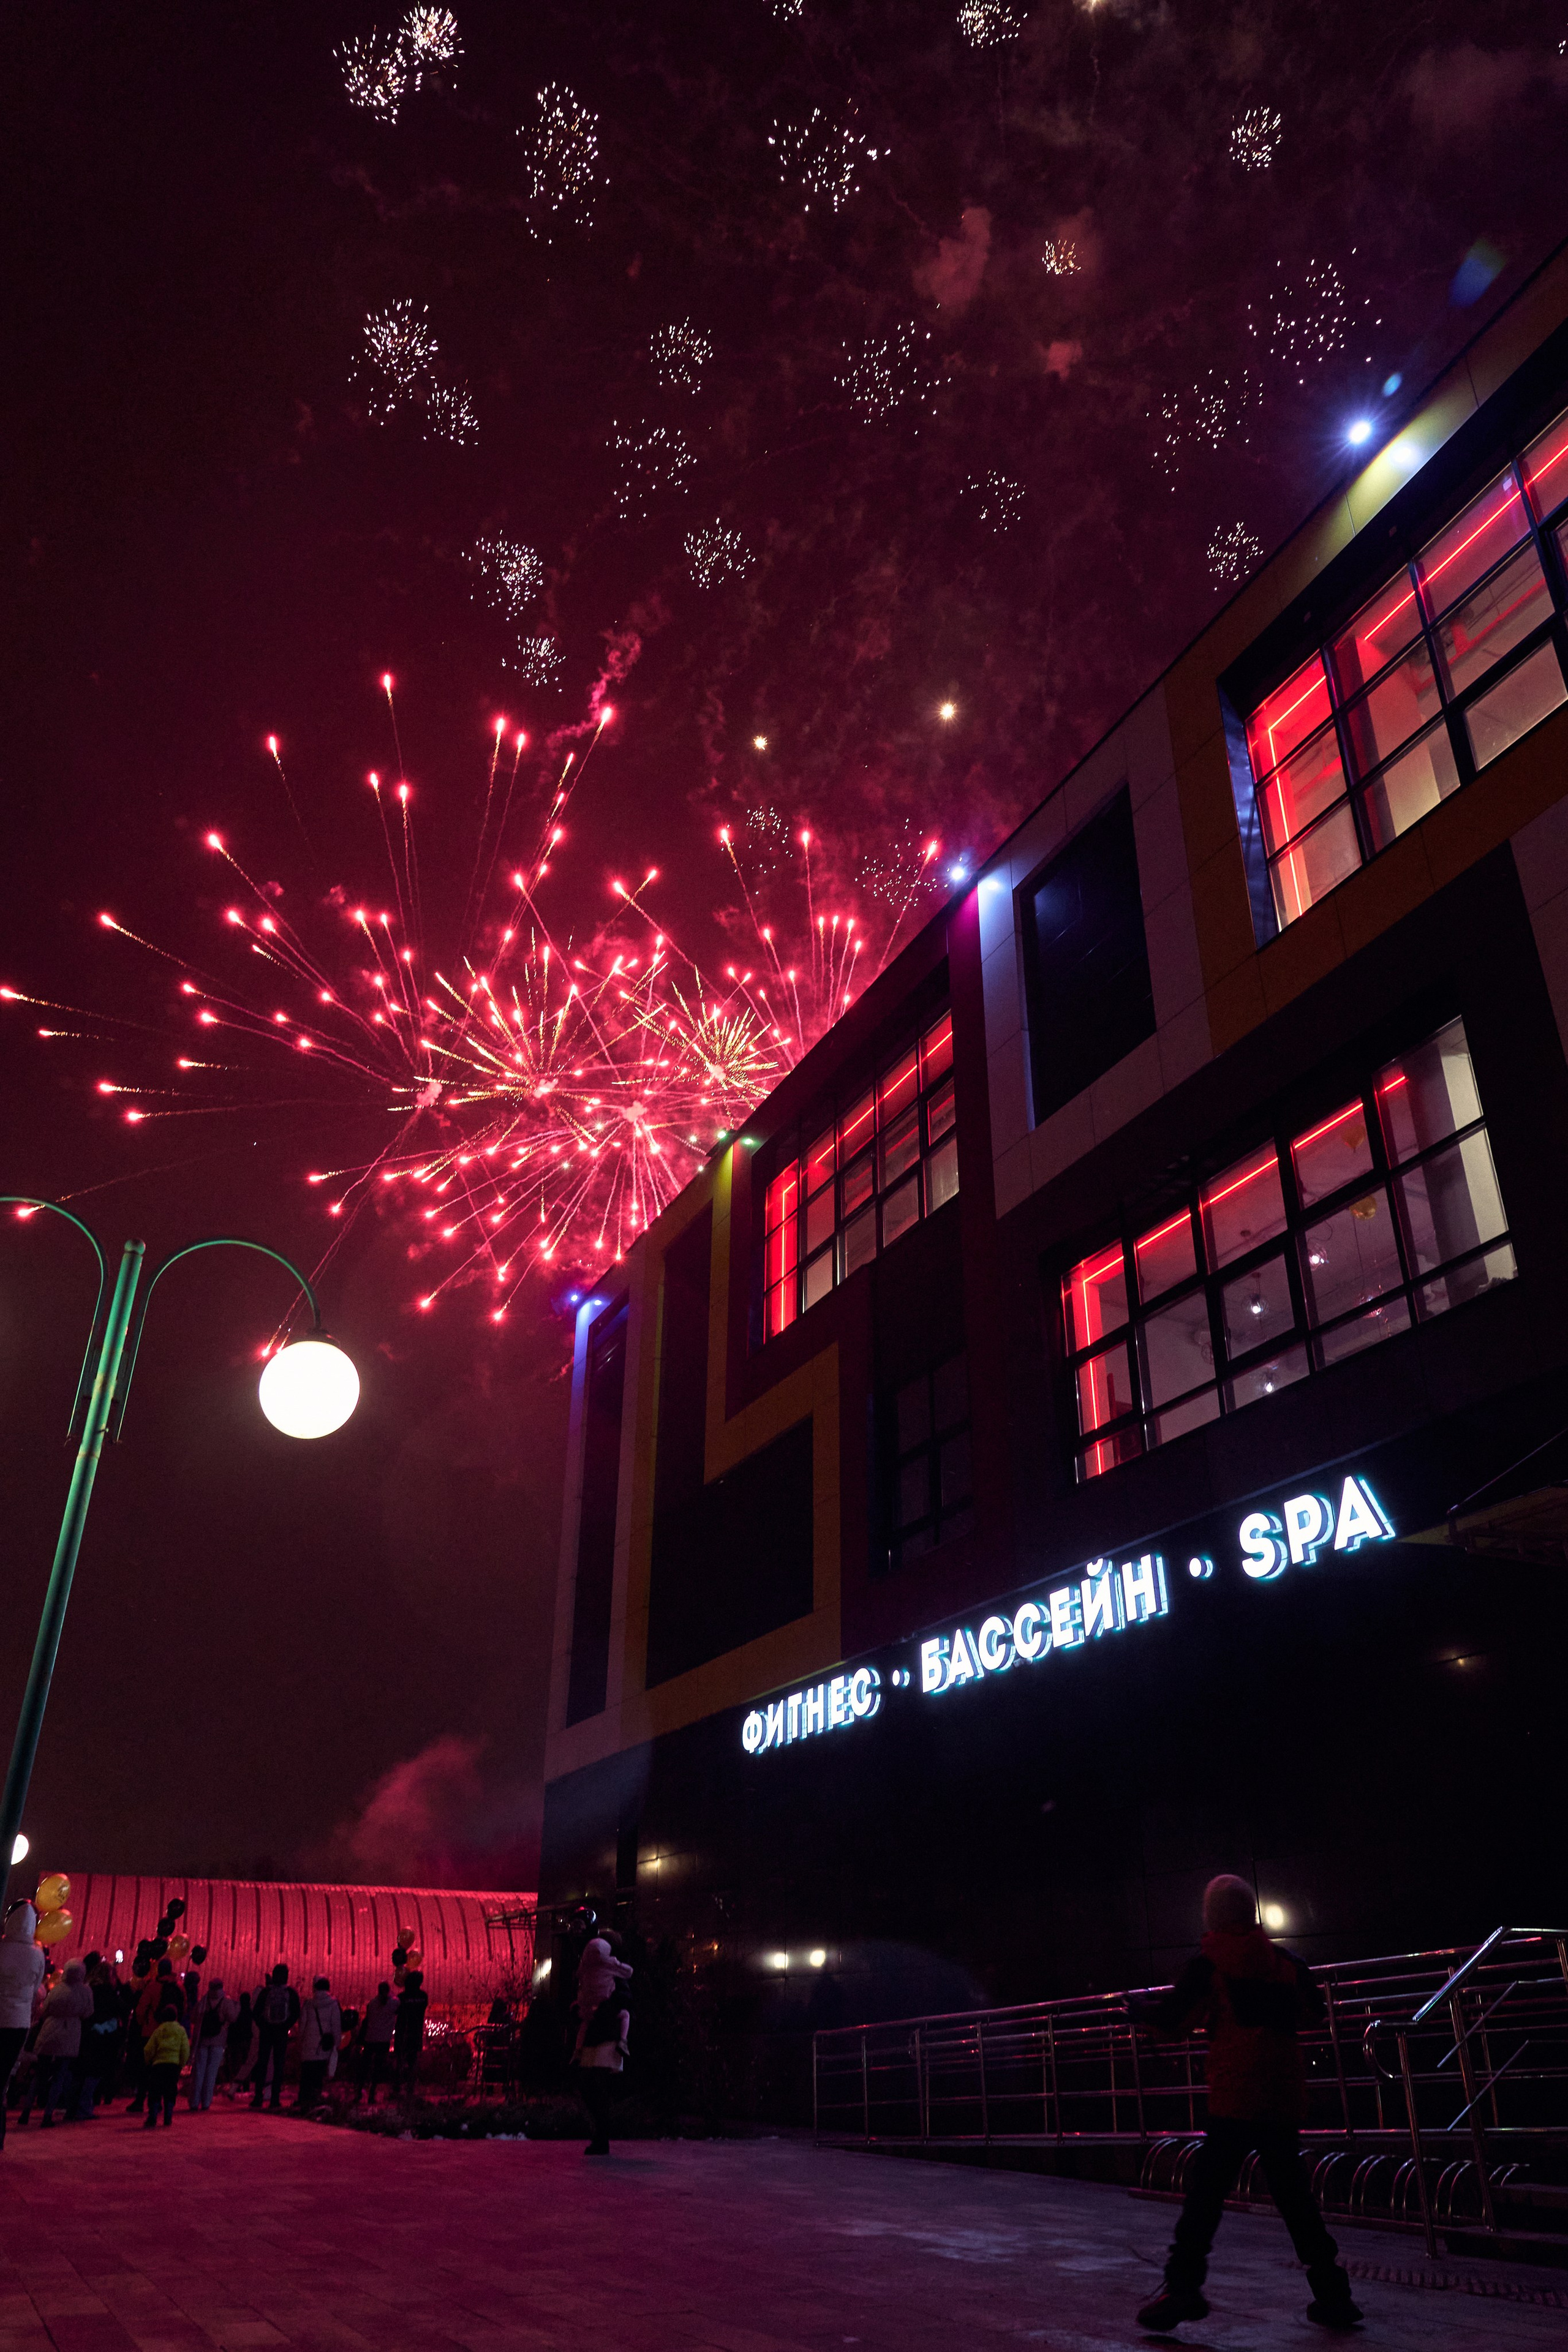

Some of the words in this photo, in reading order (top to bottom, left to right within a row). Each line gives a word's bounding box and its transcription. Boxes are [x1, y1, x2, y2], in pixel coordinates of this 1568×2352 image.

[742, 1667, 877, 1754] ФИТНЕС
[921, 1553, 1163, 1694] БАССЕЙН
[1238, 1475, 1389, 1578] SPA
